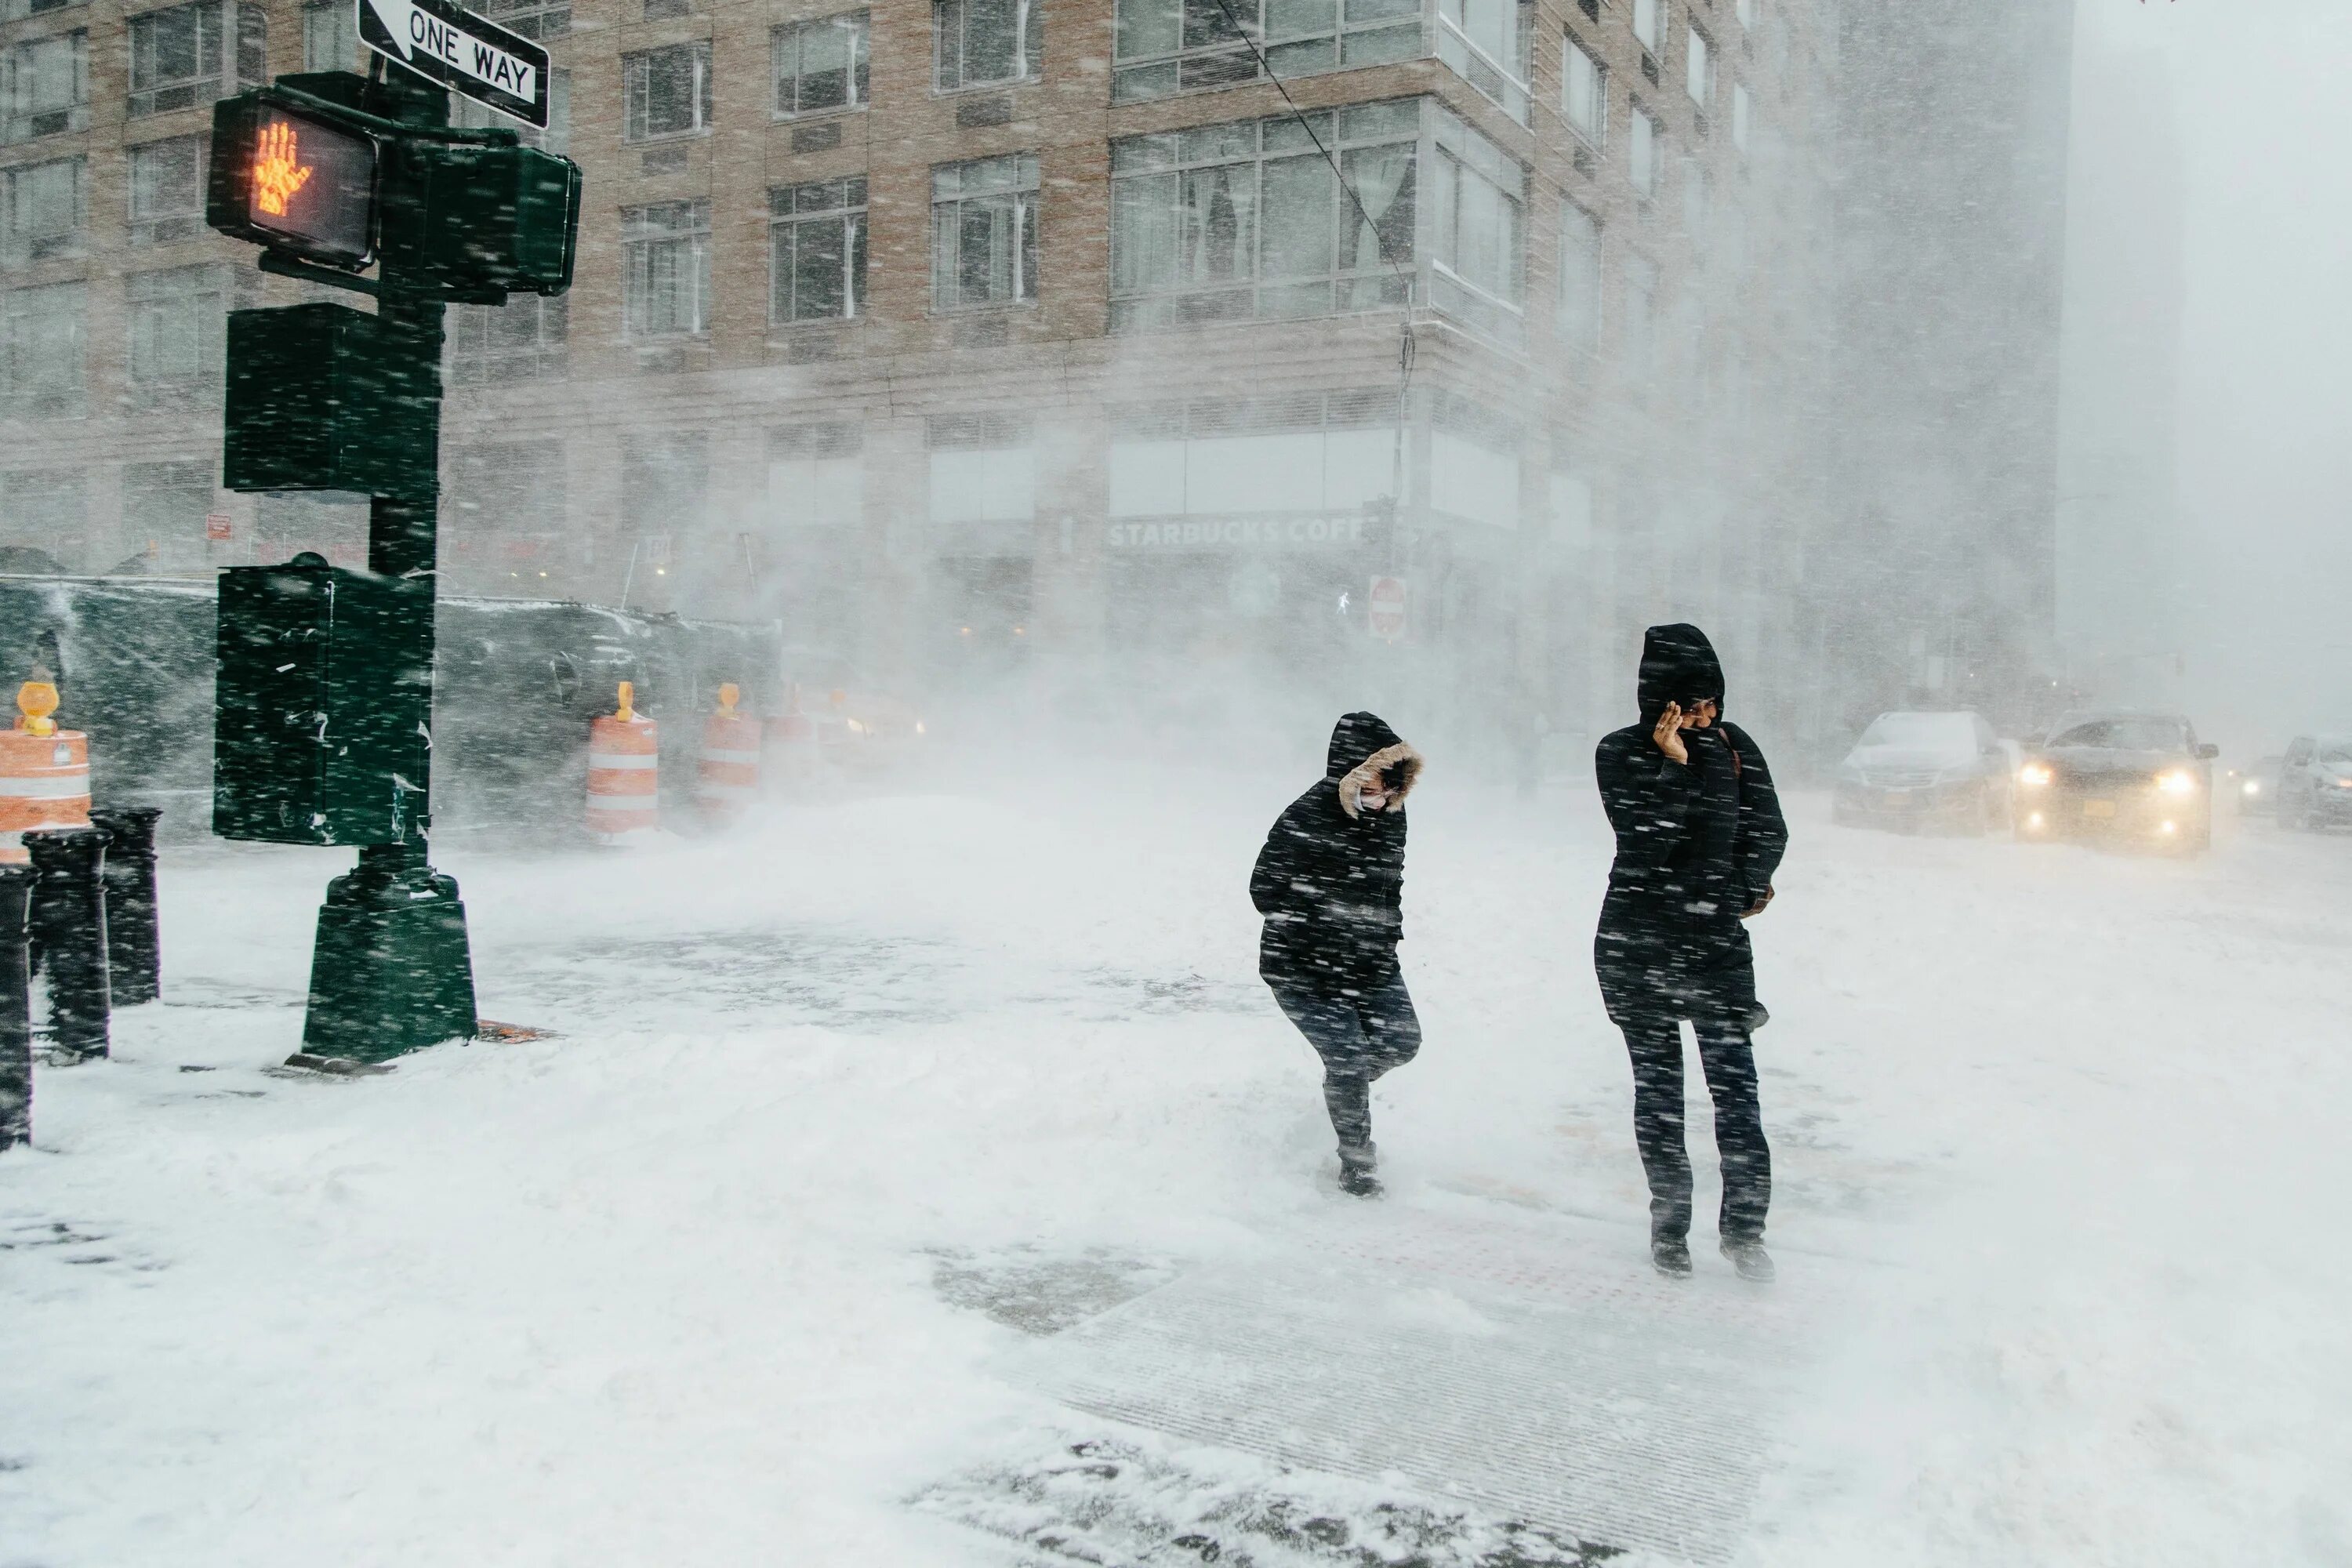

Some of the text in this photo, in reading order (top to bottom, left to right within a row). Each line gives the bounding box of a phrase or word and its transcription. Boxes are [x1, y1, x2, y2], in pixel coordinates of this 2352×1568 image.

[410, 10, 528, 93] ONE WAY
[1109, 516, 1403, 546] STARBUCKS COFF
